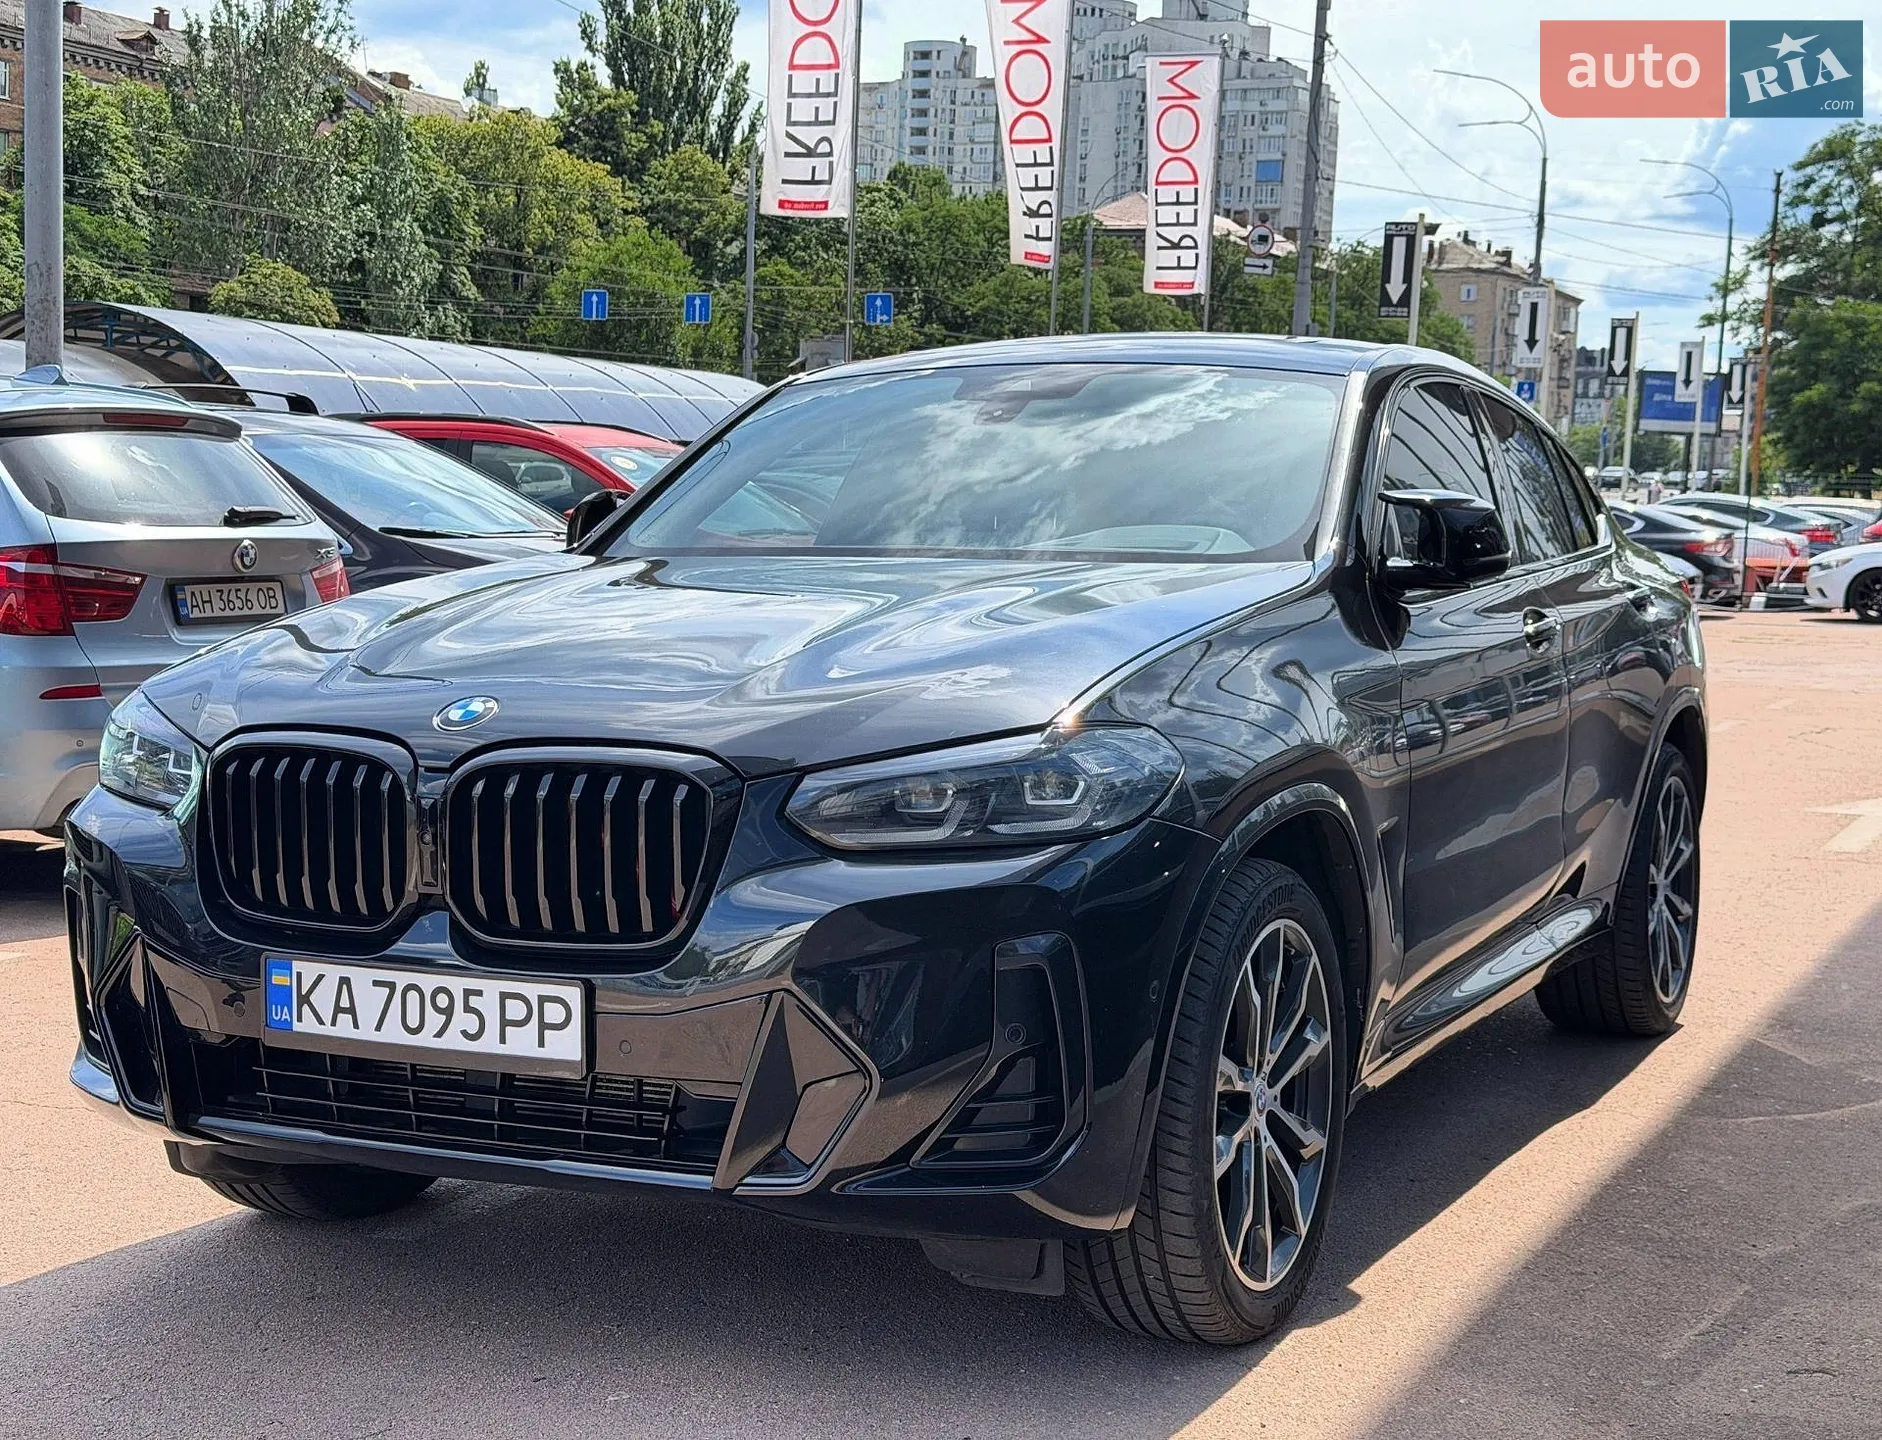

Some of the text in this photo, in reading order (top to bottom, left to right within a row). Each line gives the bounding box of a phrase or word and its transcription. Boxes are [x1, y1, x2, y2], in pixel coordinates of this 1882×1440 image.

[190, 590, 215, 615] AH
[216, 587, 254, 613] 3656
[256, 586, 279, 611] OB
[272, 970, 573, 1049] UA KA 7095 PP
